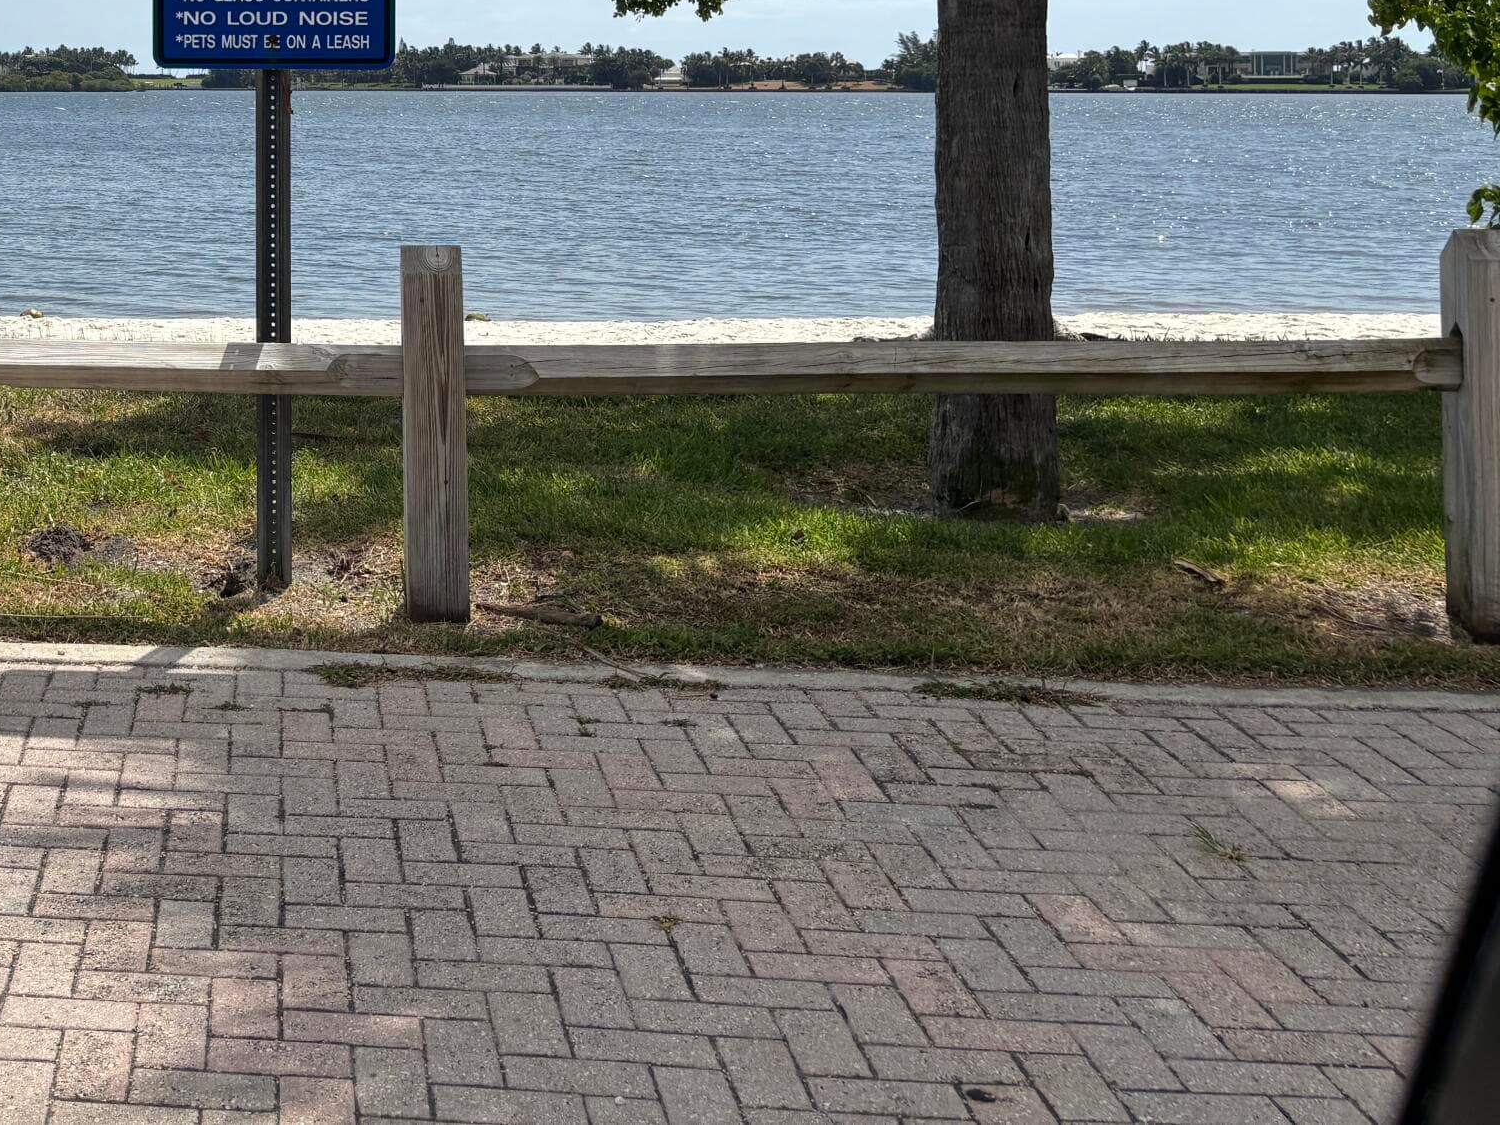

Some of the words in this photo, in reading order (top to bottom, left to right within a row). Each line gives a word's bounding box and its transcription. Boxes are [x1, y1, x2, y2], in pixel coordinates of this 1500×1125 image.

[227, 11, 287, 25] LOUD
[299, 11, 368, 25] NOISE
[222, 35, 257, 48] MUST
[286, 35, 306, 49] ON
[312, 35, 321, 48] A
[327, 35, 370, 48] LEASH
